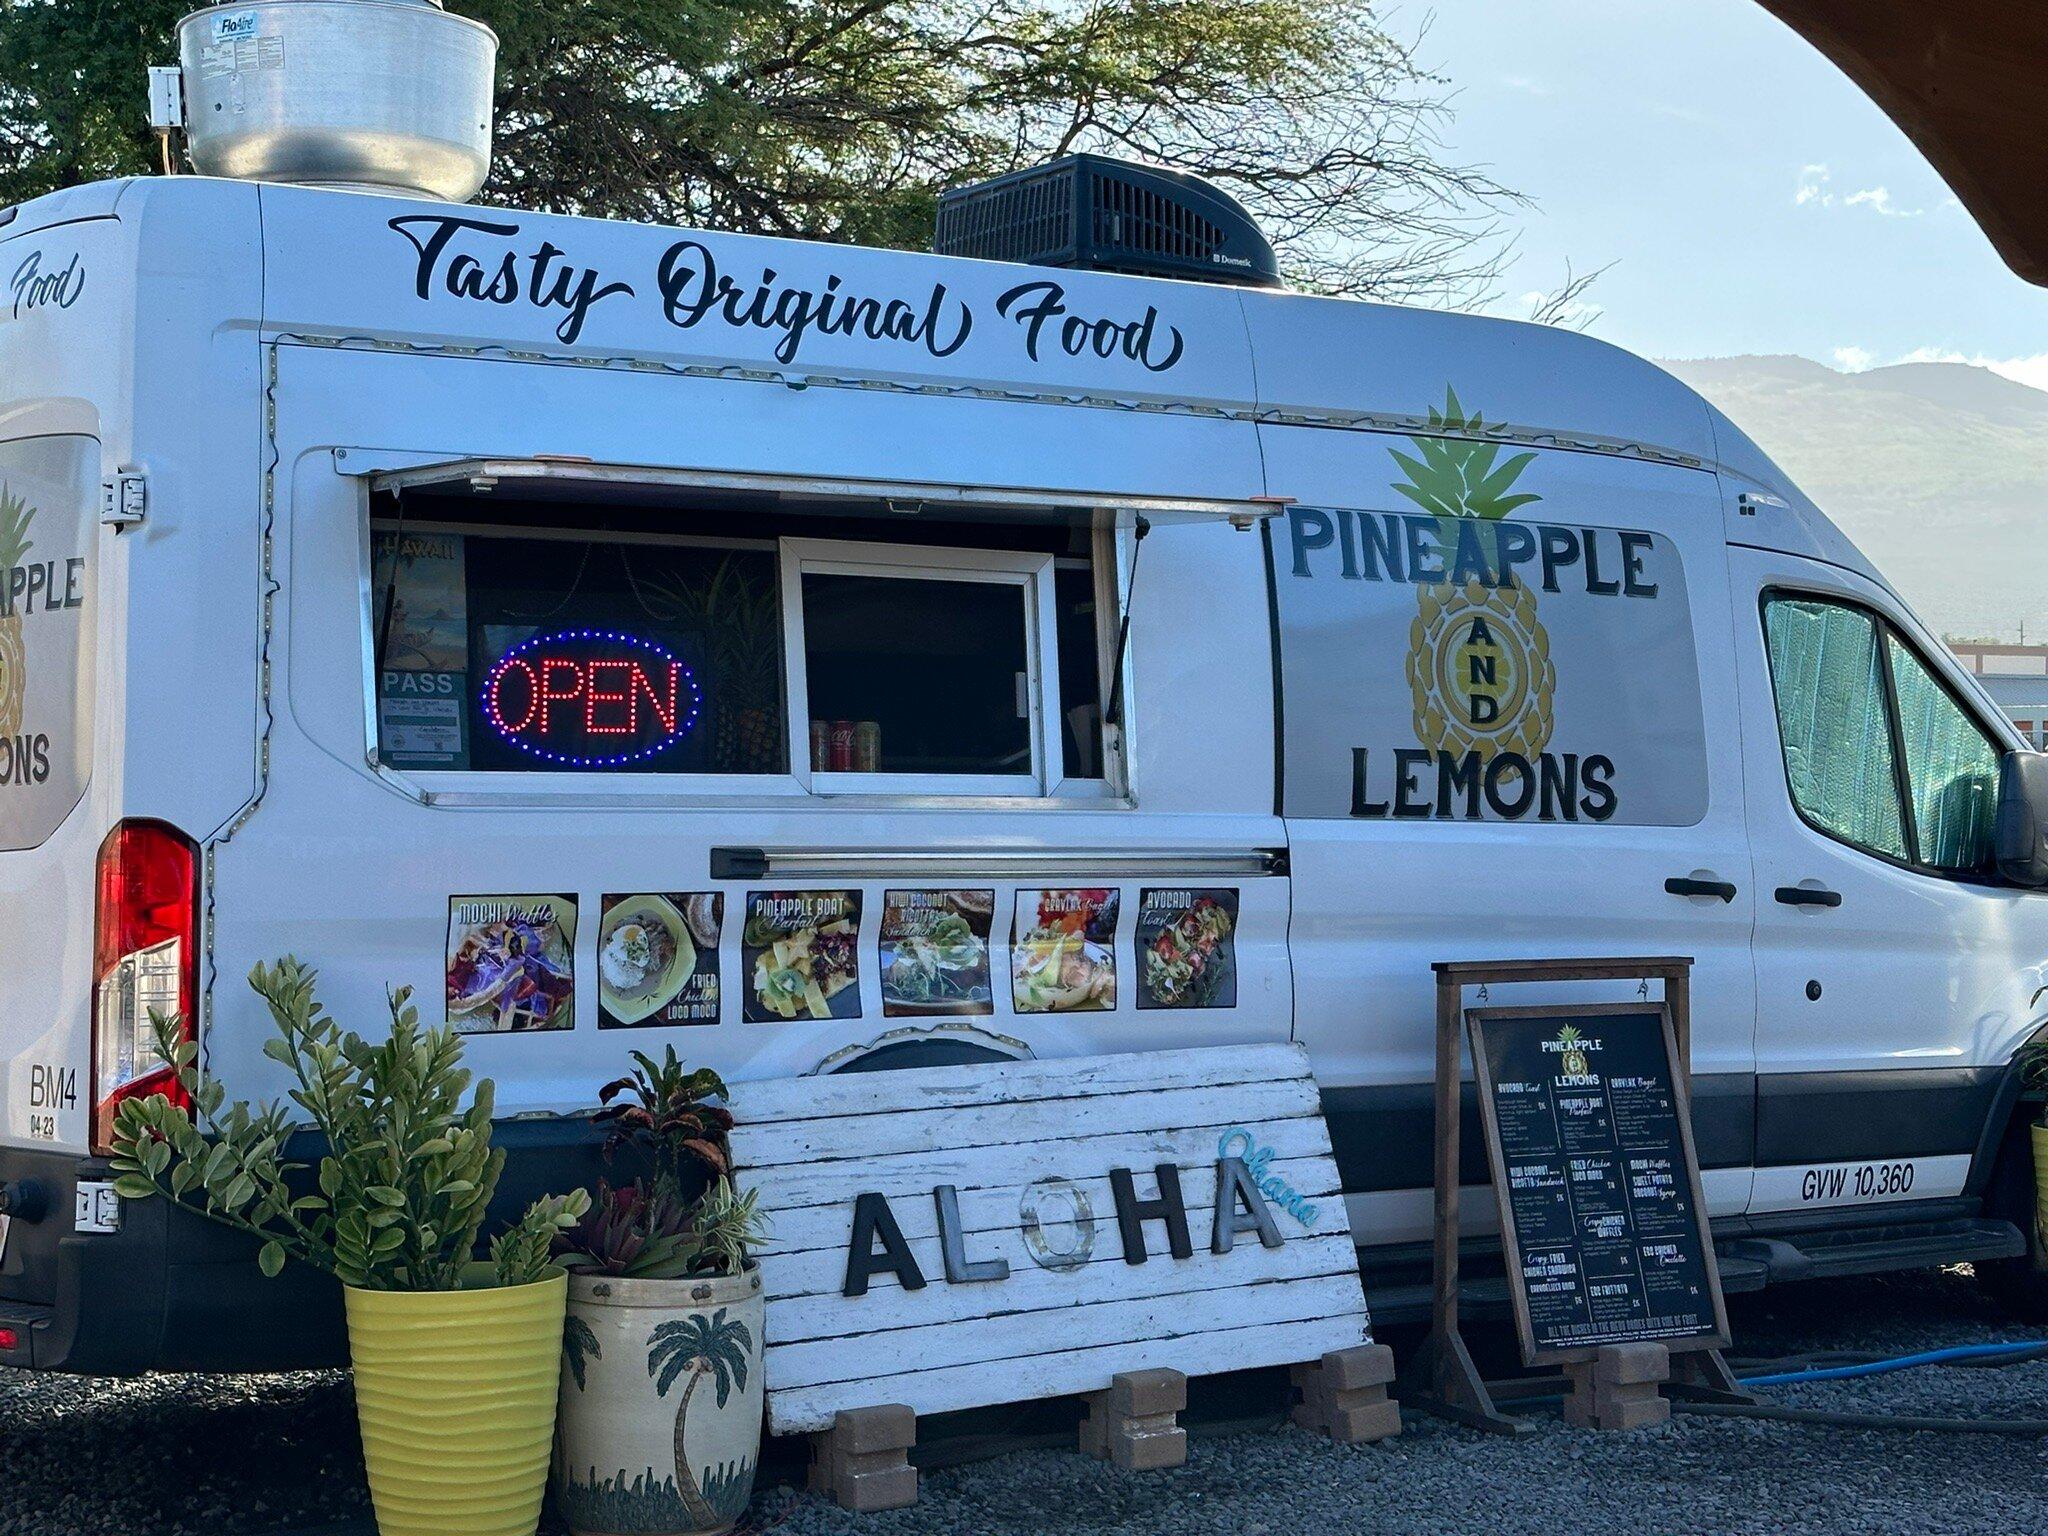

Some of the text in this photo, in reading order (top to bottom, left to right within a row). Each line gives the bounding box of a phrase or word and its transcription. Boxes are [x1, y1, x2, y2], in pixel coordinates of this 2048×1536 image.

[10, 250, 85, 320] Food
[387, 215, 1185, 372] Tasty Original Food
[1286, 508, 1659, 598] PINEAPPLE
[384, 671, 453, 694] PASS
[491, 657, 678, 733] OPEN
[1350, 747, 1618, 822] LEMONS
[458, 902, 559, 925] MOCHI Waffles
[756, 897, 845, 917] PINEAPPLE BOAT
[1147, 891, 1192, 909] AVOCADO
[692, 973, 718, 989] FRIED
[1541, 1039, 1603, 1052] PINEAPPLE
[31, 1064, 76, 1110] BM4
[1555, 1074, 1600, 1087] LEMONS
[44, 1116, 54, 1135] 23
[1802, 1163, 1914, 1200] GVW 10,360
[842, 1156, 1284, 1297] ALOHA
